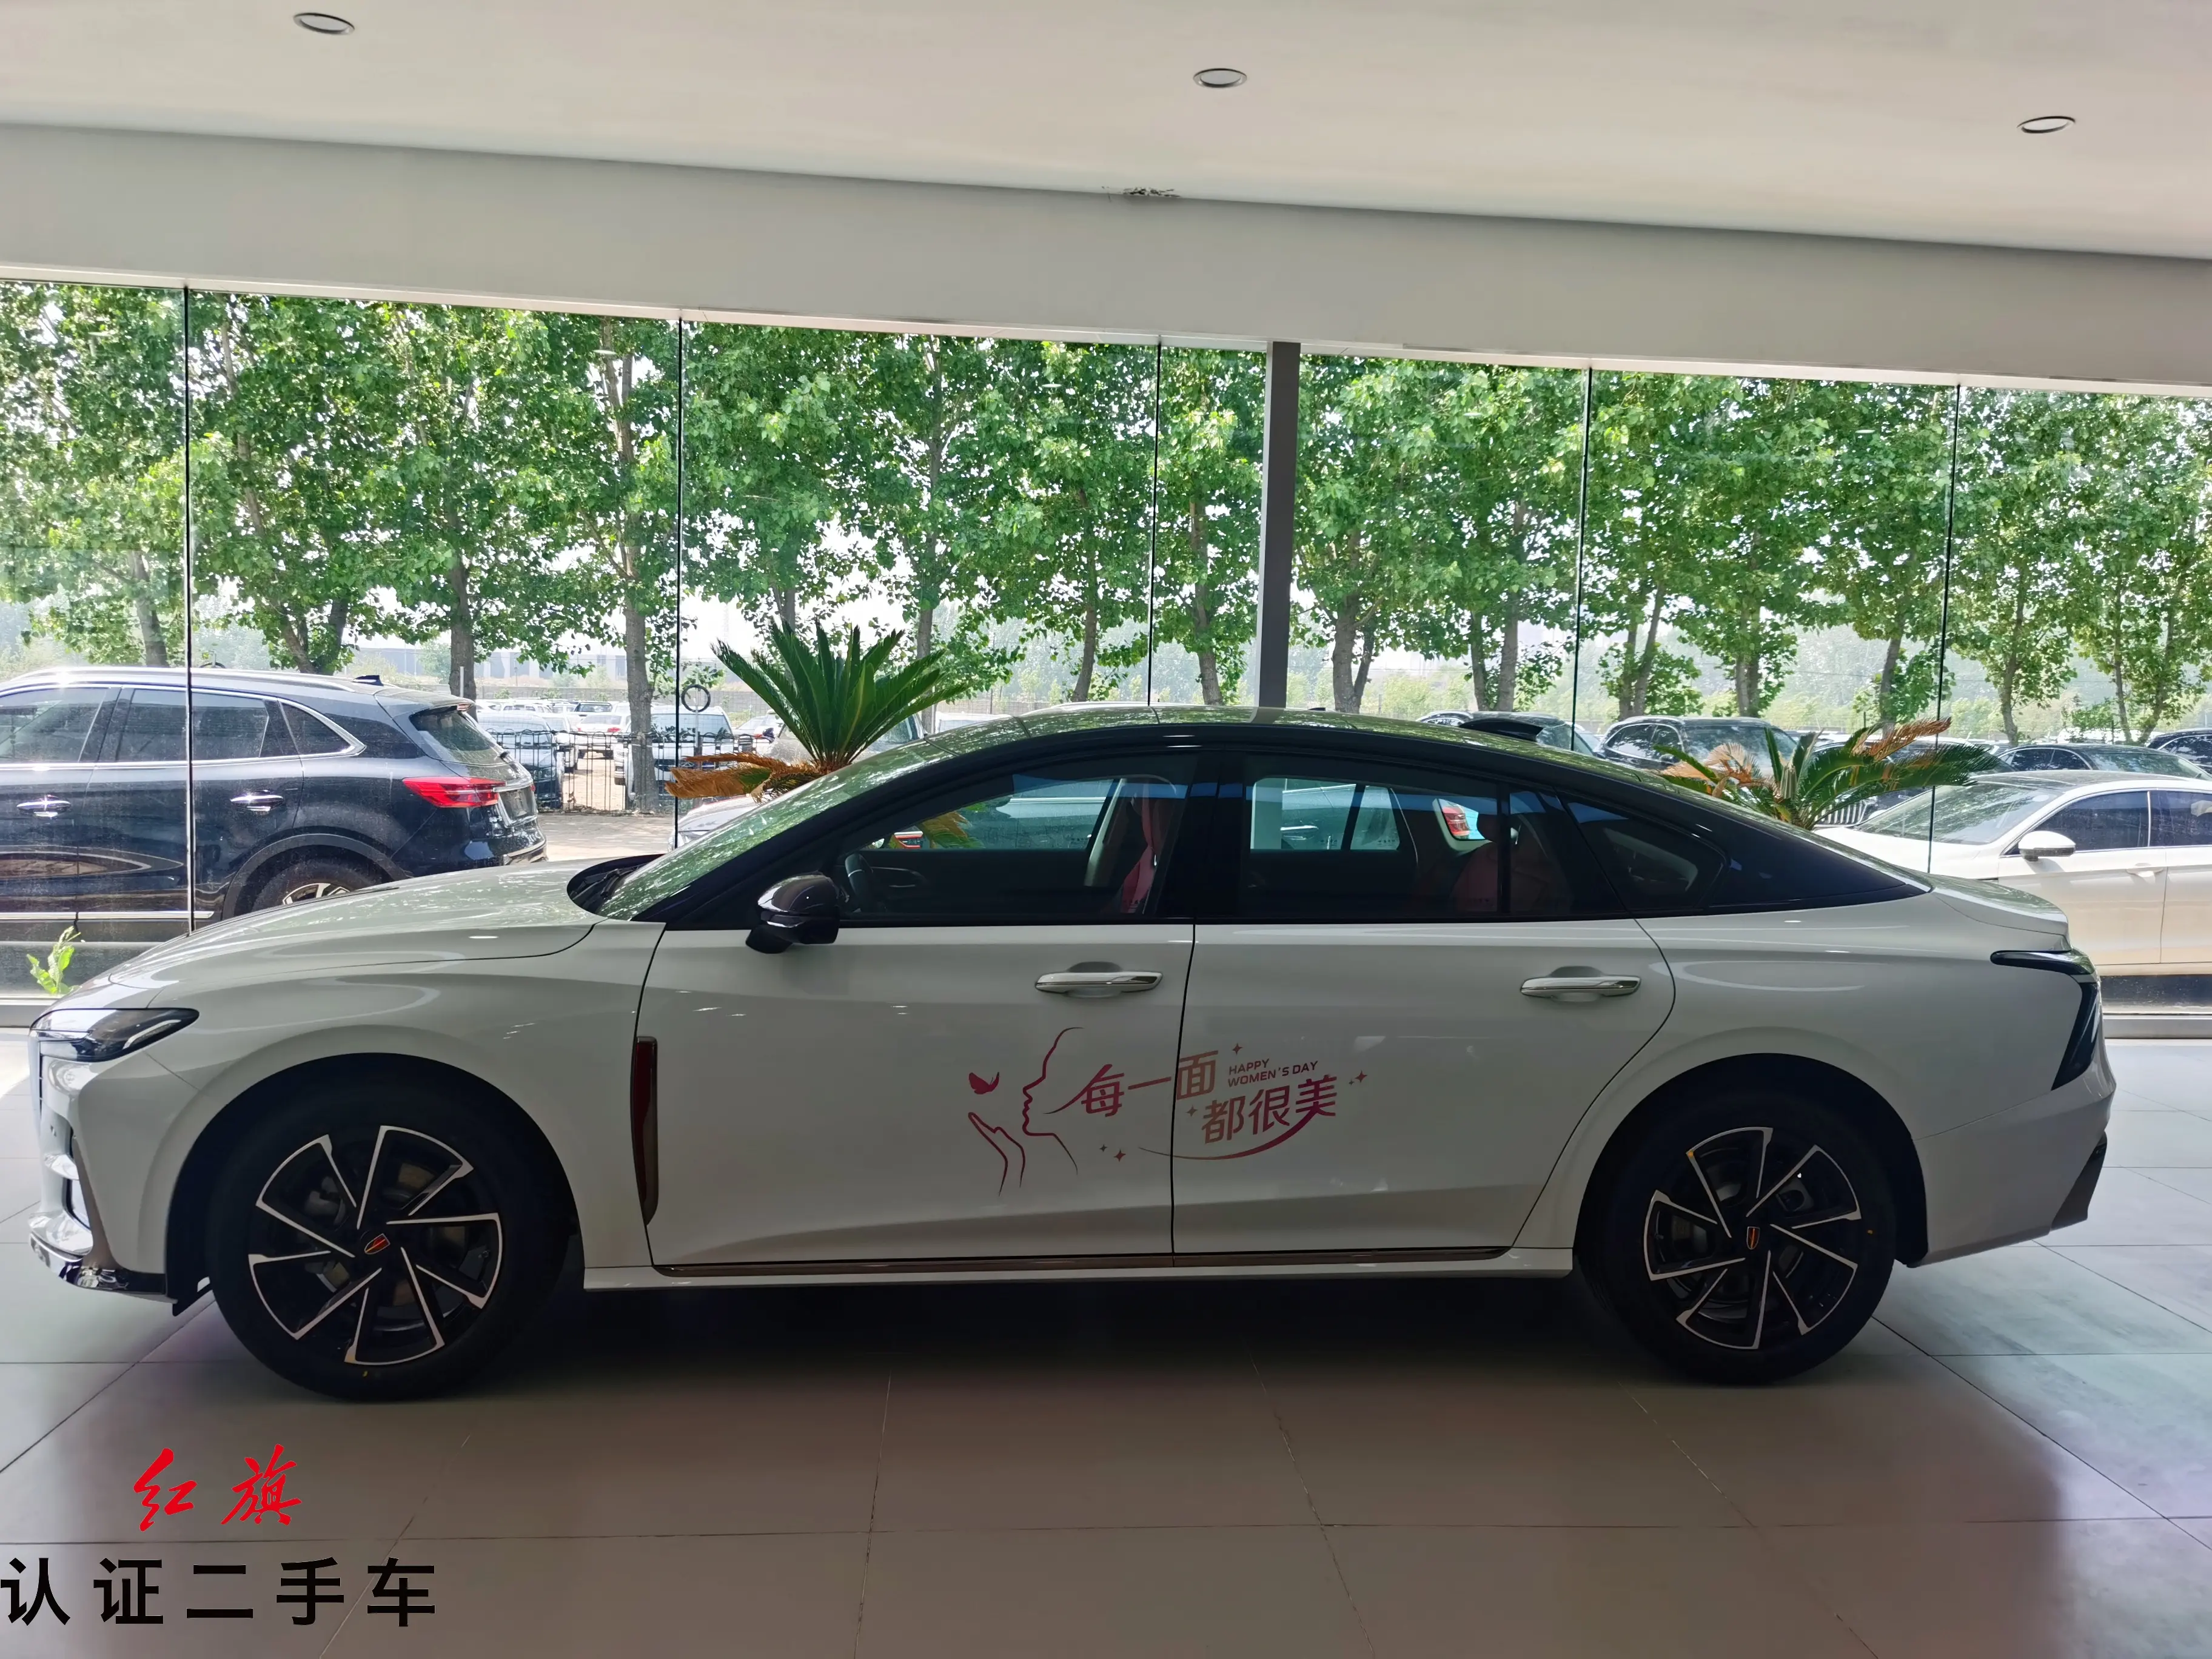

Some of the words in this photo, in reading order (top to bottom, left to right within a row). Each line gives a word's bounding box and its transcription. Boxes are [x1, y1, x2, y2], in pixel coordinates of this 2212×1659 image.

[1077, 1050, 1219, 1118] 每一面
[1227, 1066, 1290, 1088] WOMEN'S
[1292, 1060, 1319, 1074] DAY
[1228, 1058, 1270, 1076] HAPPY
[1201, 1074, 1338, 1145] 都很美
